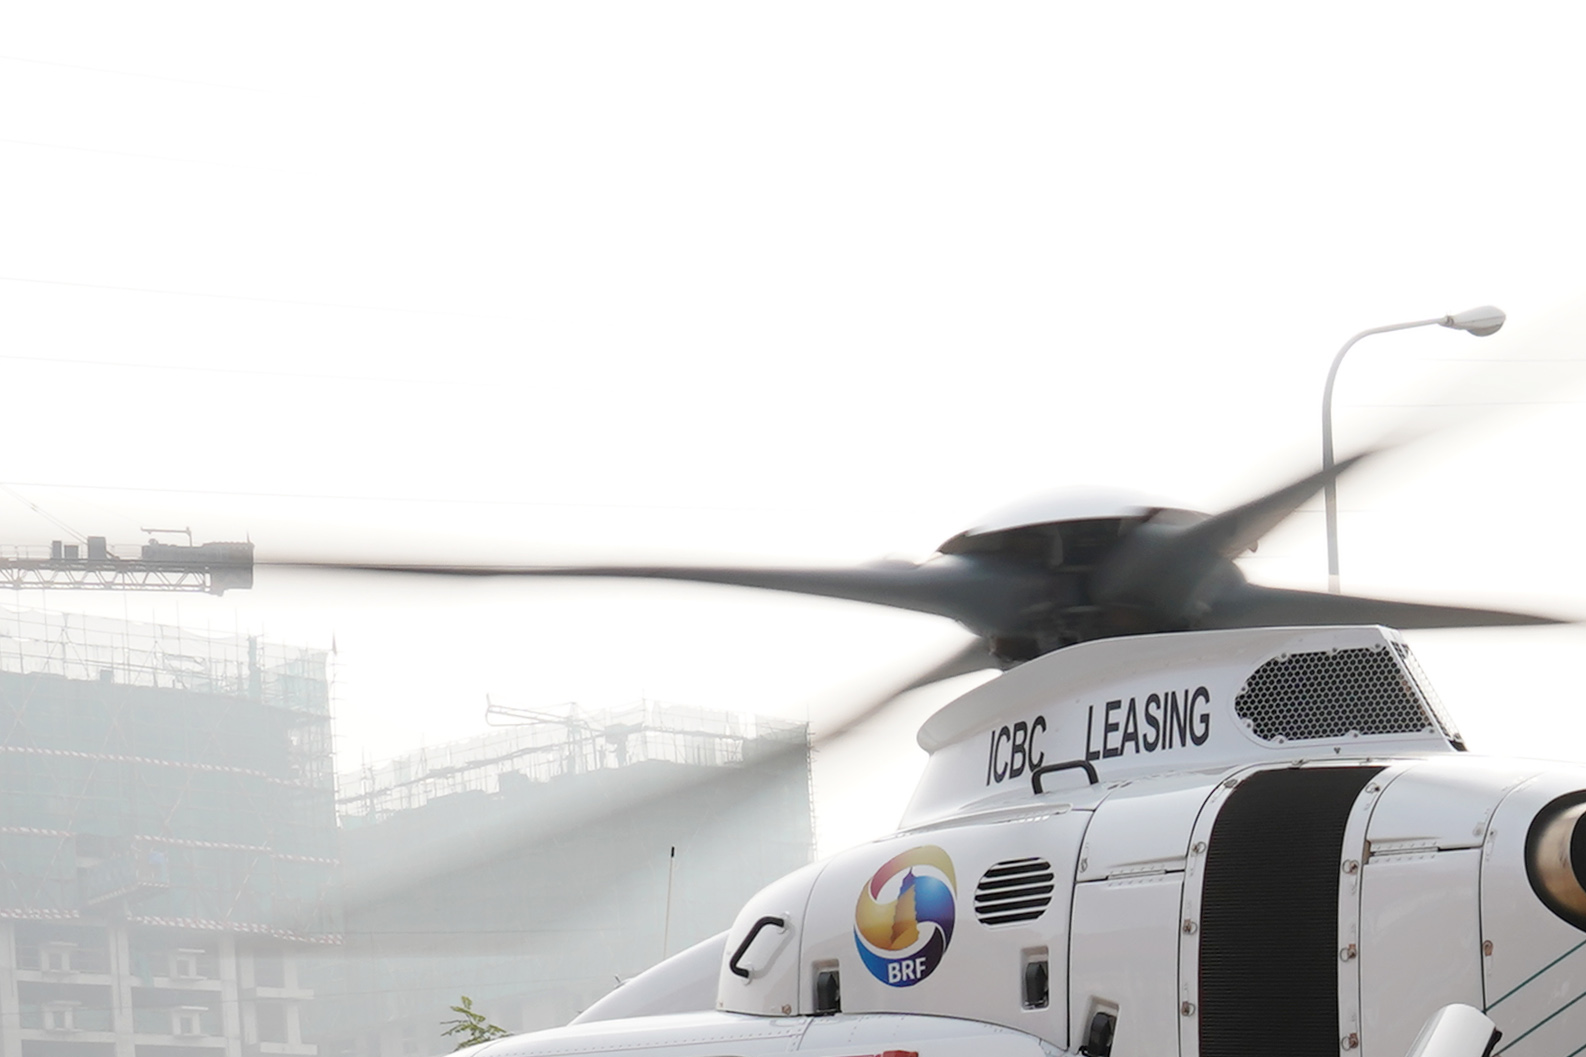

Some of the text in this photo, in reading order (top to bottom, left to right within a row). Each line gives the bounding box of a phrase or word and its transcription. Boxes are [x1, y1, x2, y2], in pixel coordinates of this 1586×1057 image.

[986, 686, 1210, 786] ICBC LEASING
[887, 957, 926, 983] BRF
